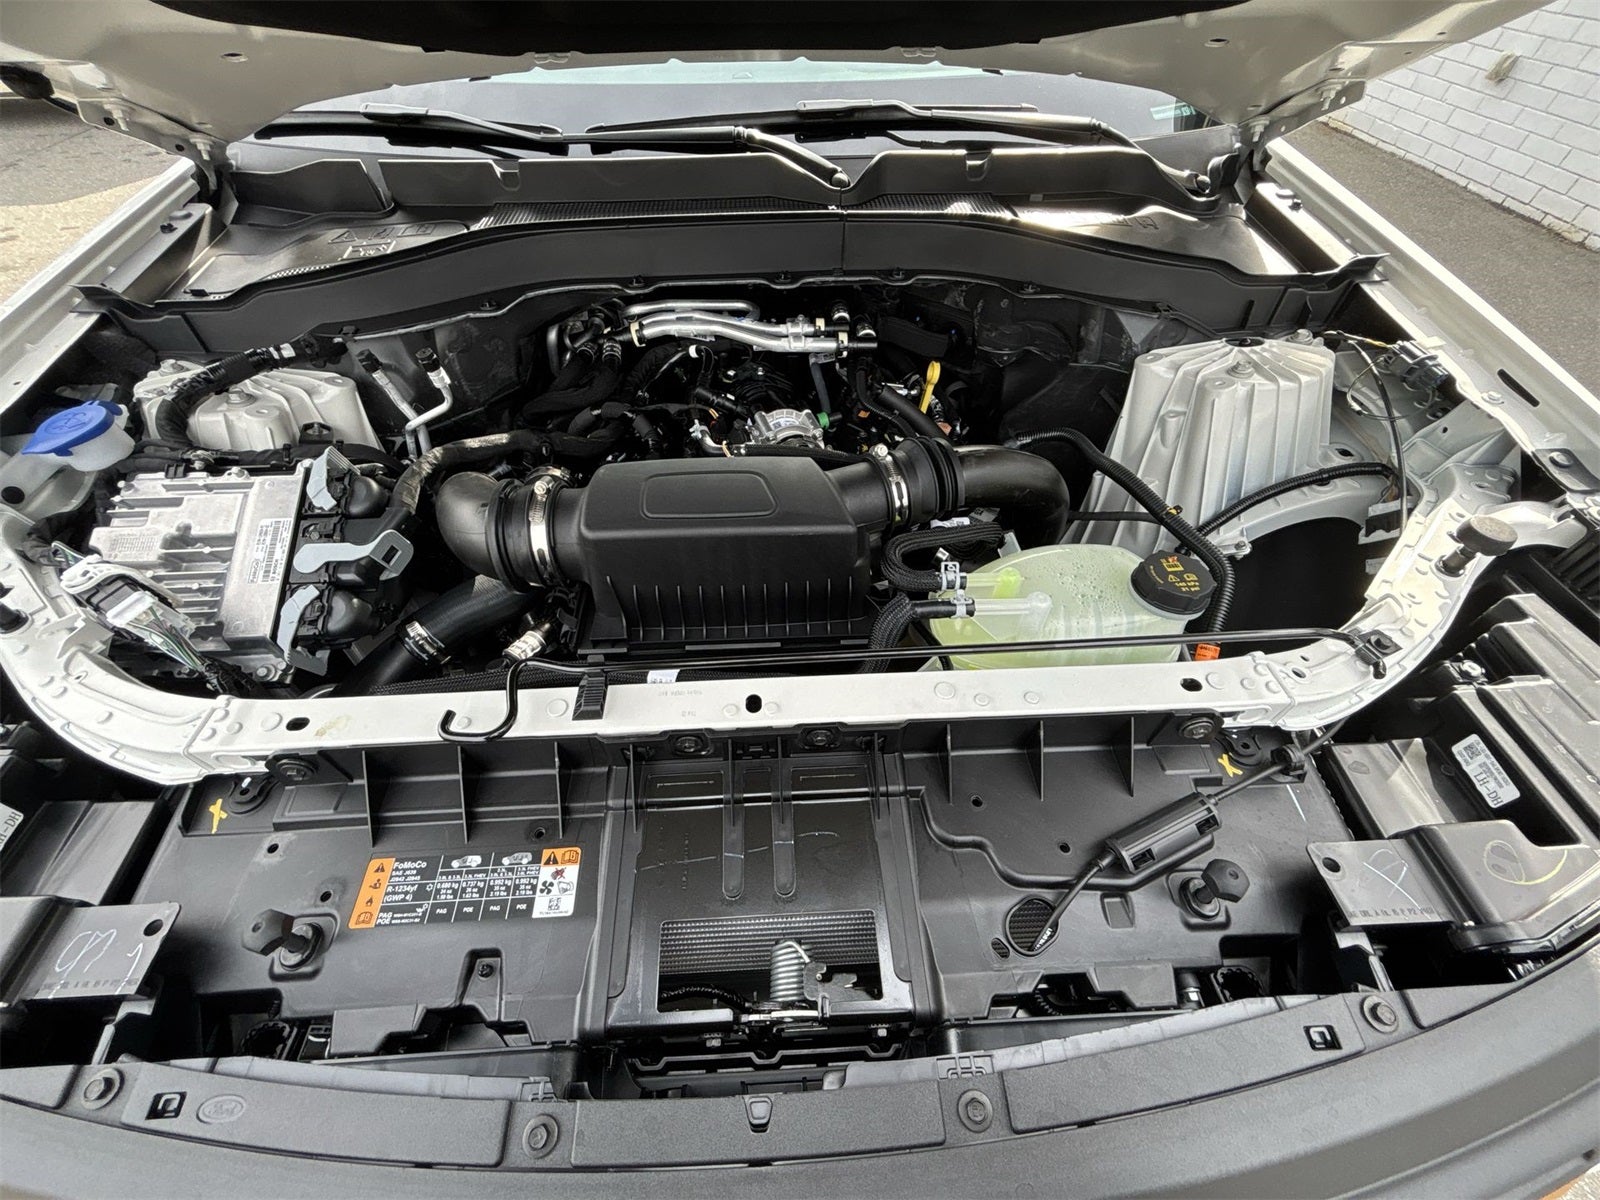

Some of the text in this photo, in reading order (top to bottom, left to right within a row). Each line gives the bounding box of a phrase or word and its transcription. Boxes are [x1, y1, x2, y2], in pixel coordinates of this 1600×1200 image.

[1474, 771, 1504, 806] LH-DH
[393, 861, 427, 870] FoMoCo
[386, 884, 418, 894] R-1234yf
[384, 895, 404, 903] (GWP
